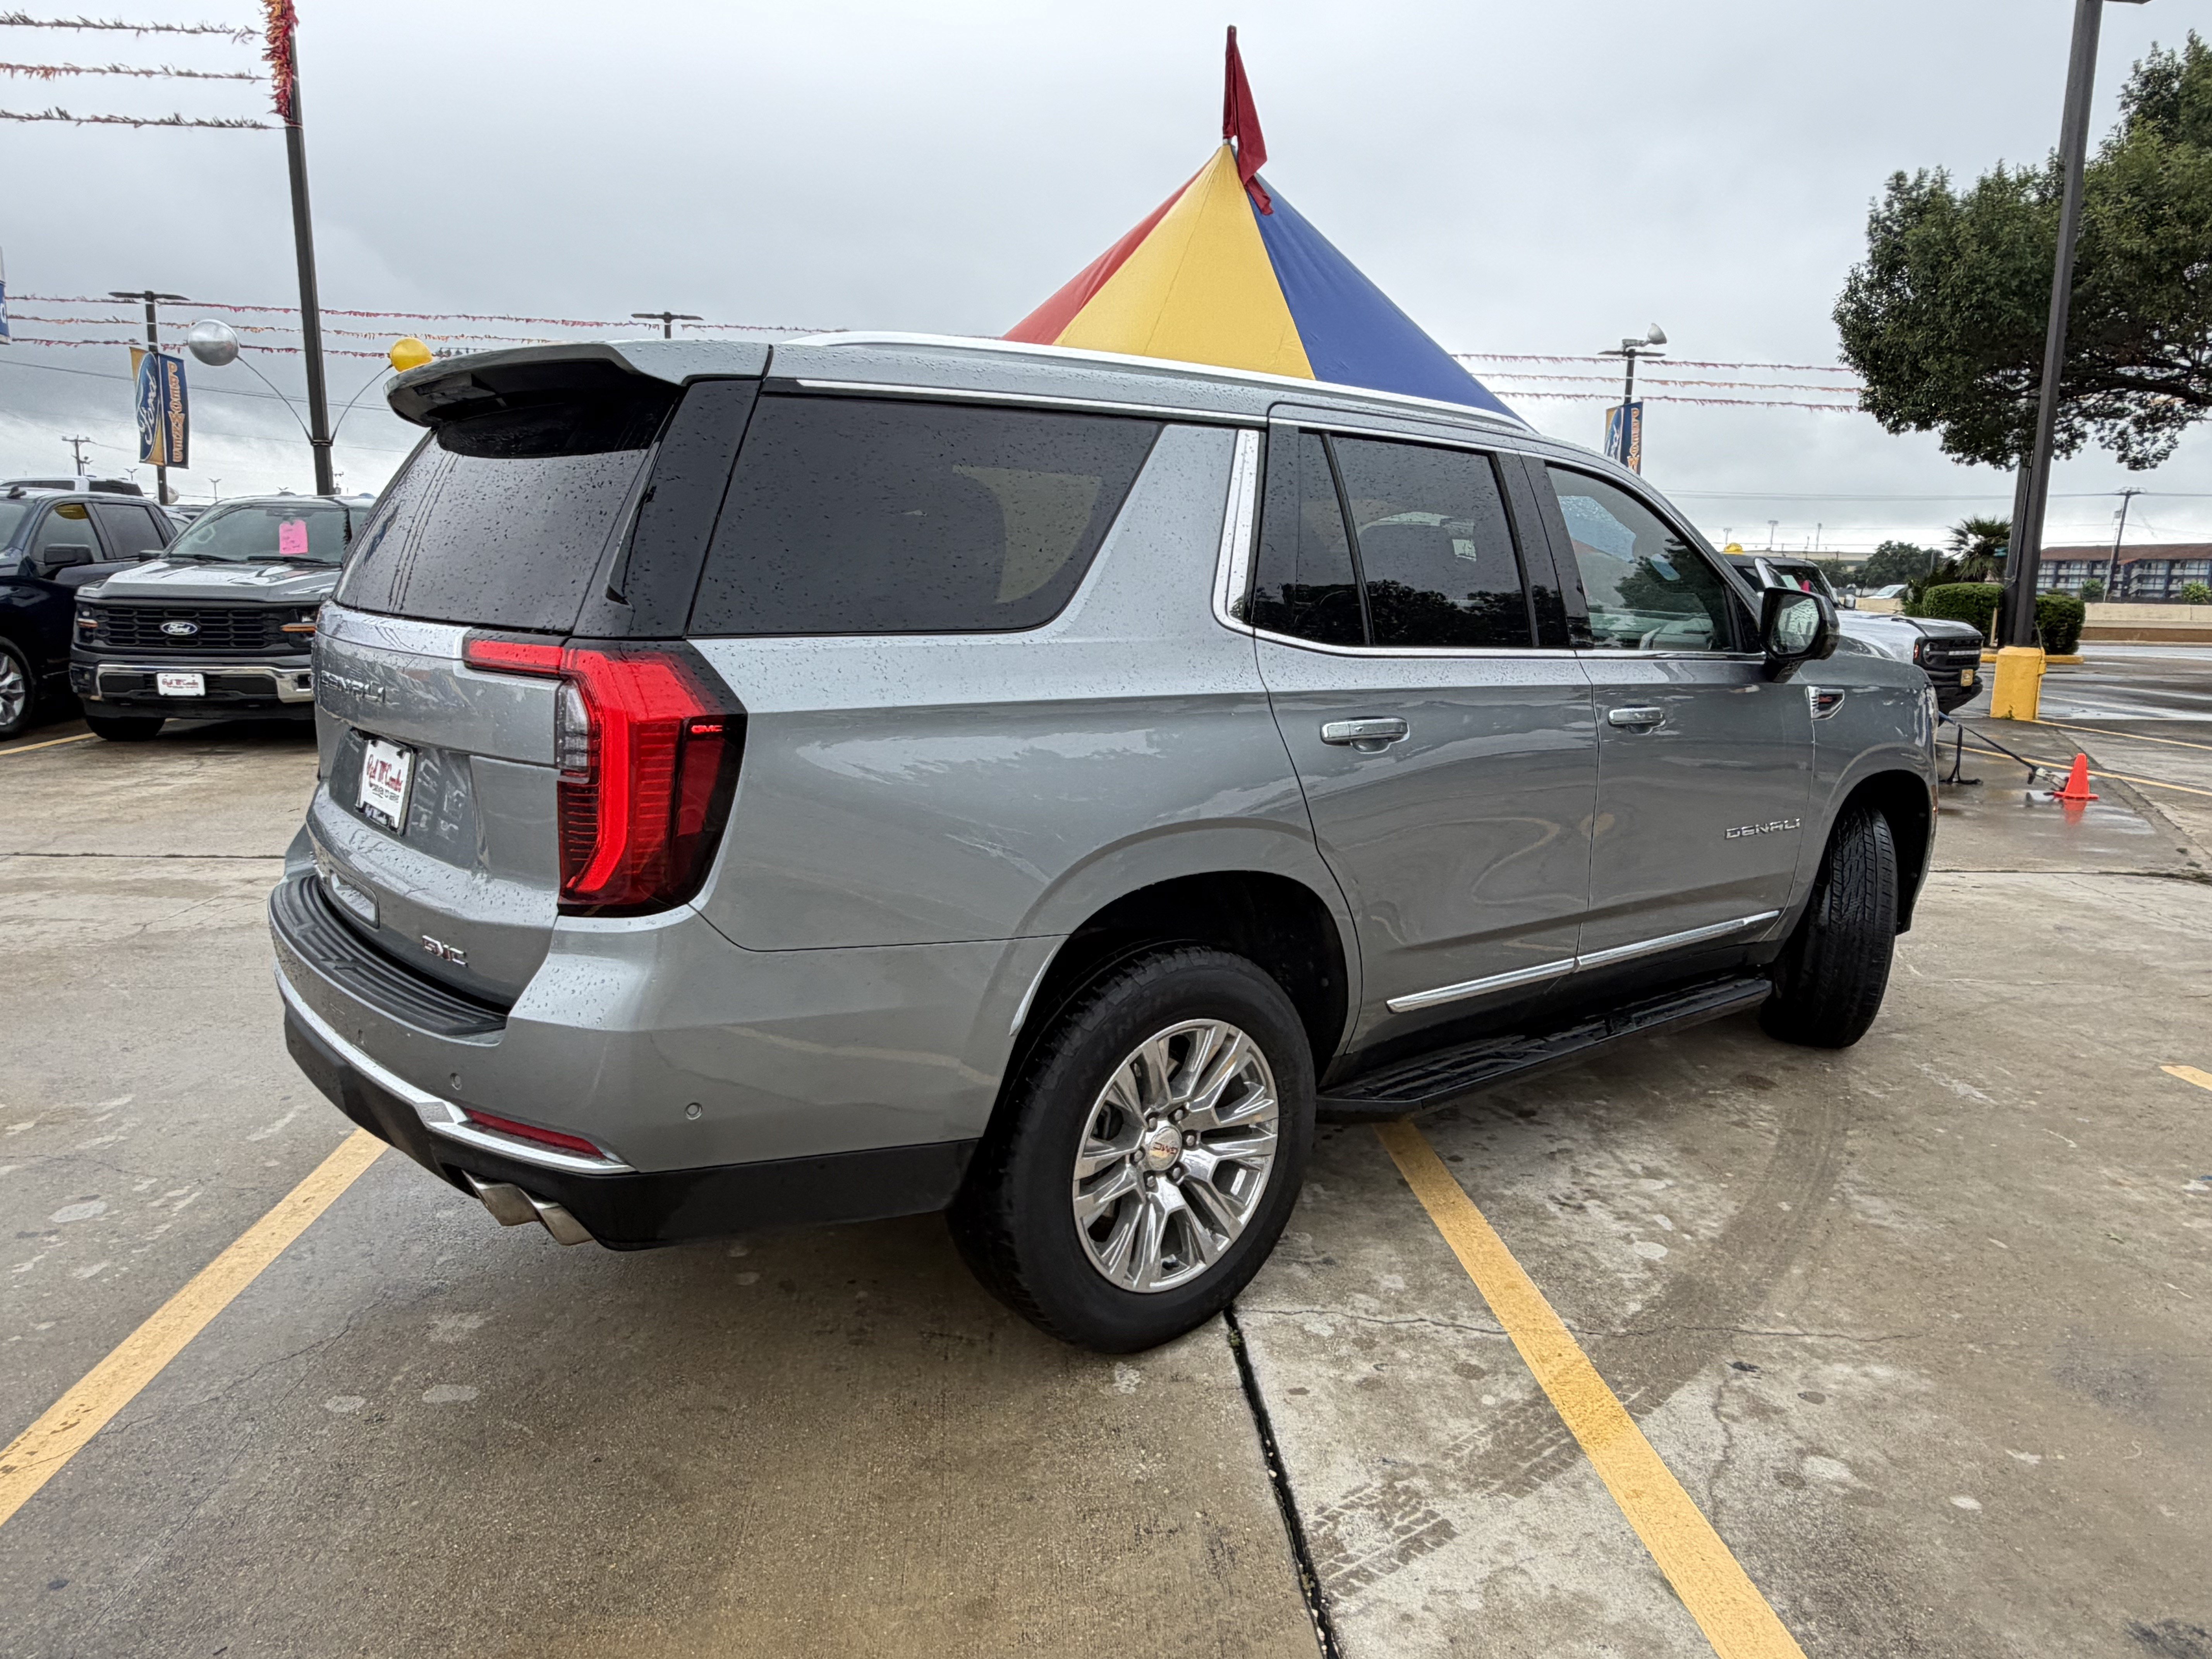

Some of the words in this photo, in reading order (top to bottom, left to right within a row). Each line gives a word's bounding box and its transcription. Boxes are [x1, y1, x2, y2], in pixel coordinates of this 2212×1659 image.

[138, 369, 157, 446] Ford
[691, 725, 723, 733] GMC
[1725, 818, 1800, 839] DENALI
[1152, 1142, 1178, 1154] GMC
